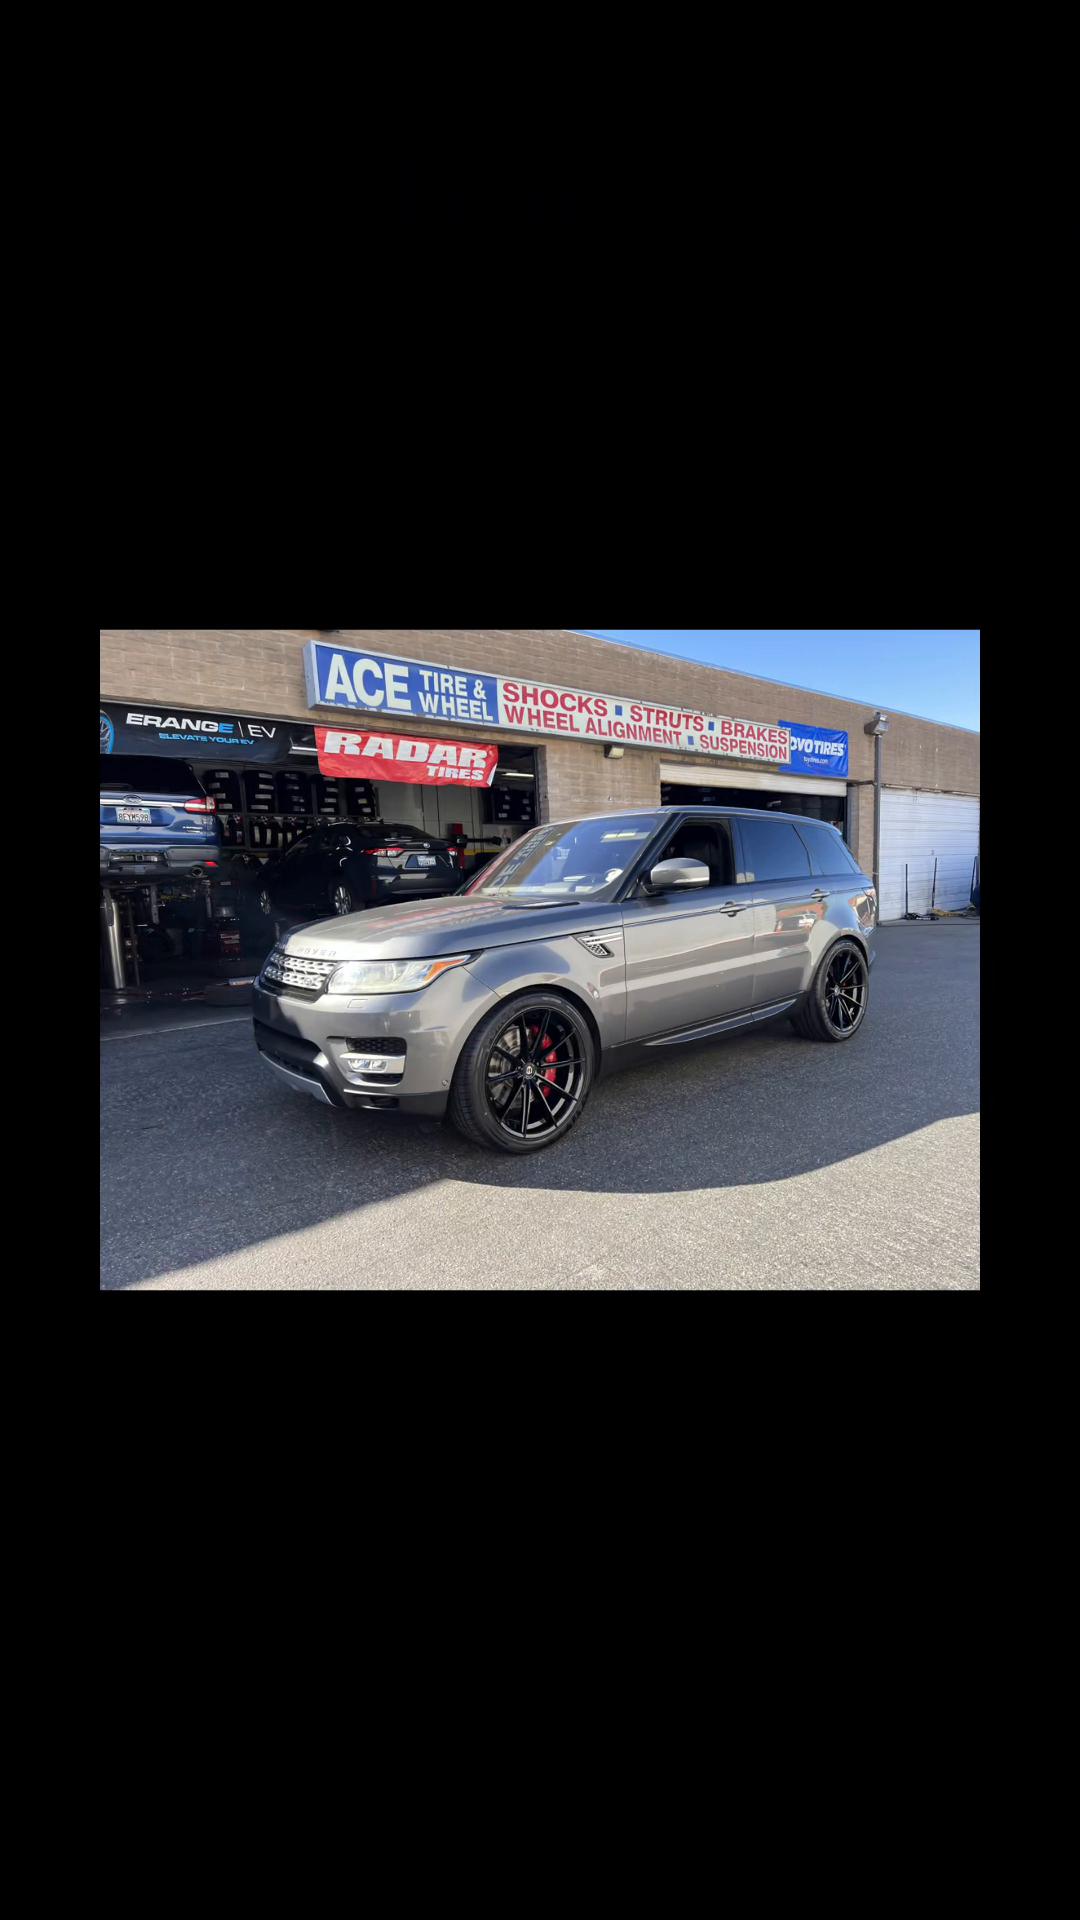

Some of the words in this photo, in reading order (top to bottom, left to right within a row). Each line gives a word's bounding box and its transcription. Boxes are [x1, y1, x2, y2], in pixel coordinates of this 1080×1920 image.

[325, 653, 412, 711] ACE
[419, 670, 468, 697] TIRE
[473, 679, 487, 700] &
[418, 691, 494, 722] WHEEL
[502, 682, 608, 717] SHOCKS
[630, 704, 705, 731] STRUTS
[721, 720, 788, 745] BRAKES
[126, 712, 234, 734] ERANGE
[247, 724, 277, 739] EV
[159, 732, 208, 742] ELEVATE
[209, 736, 239, 744] YOUR
[504, 704, 580, 732] WHEEL
[585, 717, 682, 746] ALIGNMENT
[700, 735, 787, 760] SUSPENSION
[324, 731, 488, 768] RADAR
[814, 740, 845, 757] TIRES
[426, 765, 484, 781] TIRES
